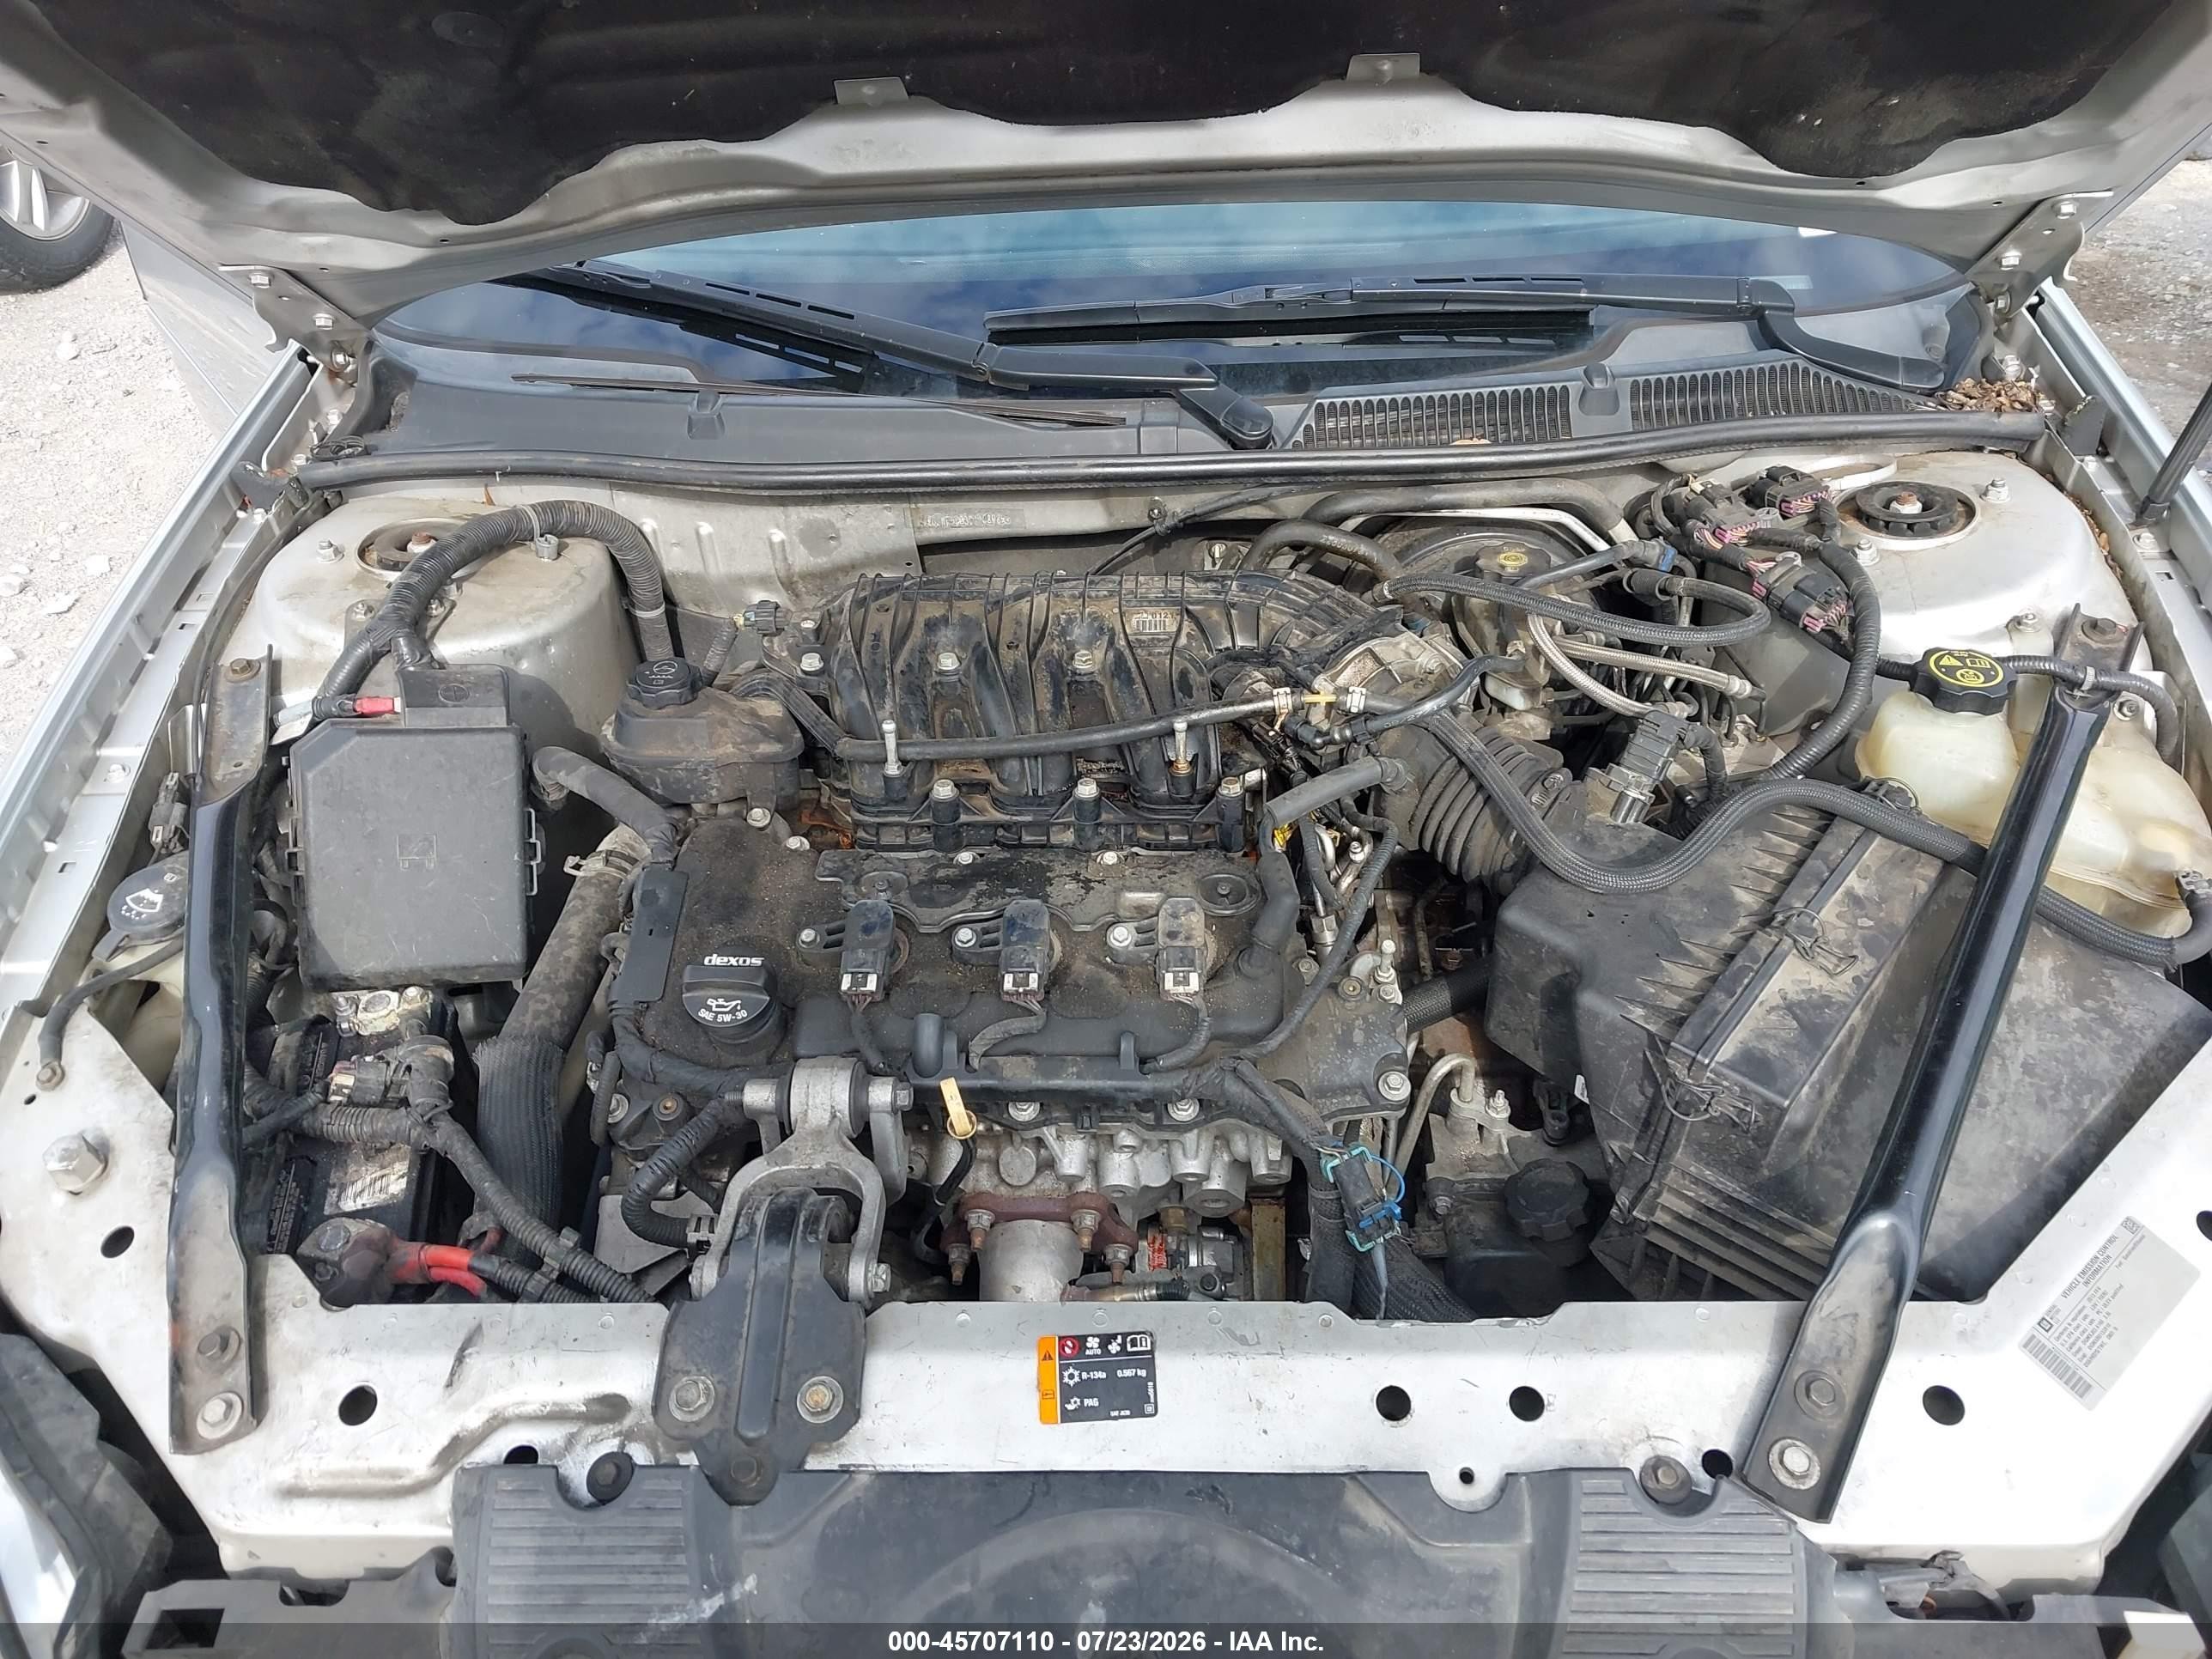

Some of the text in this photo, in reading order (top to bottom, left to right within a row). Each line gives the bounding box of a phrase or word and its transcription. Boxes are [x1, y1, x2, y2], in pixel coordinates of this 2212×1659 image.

[704, 953, 764, 967] dexos
[698, 1008, 748, 1023] SAE 5W-30
[2059, 1277, 2081, 1300] VEHICLE
[2076, 1254, 2100, 1279] EMISSION
[2096, 1232, 2118, 1257] CONTROL
[2081, 1252, 2112, 1288] INFORMATION
[1081, 1370, 1107, 1380] R-134a
[1137, 1367, 1147, 1377] kg
[1083, 1398, 1099, 1407] PAG
